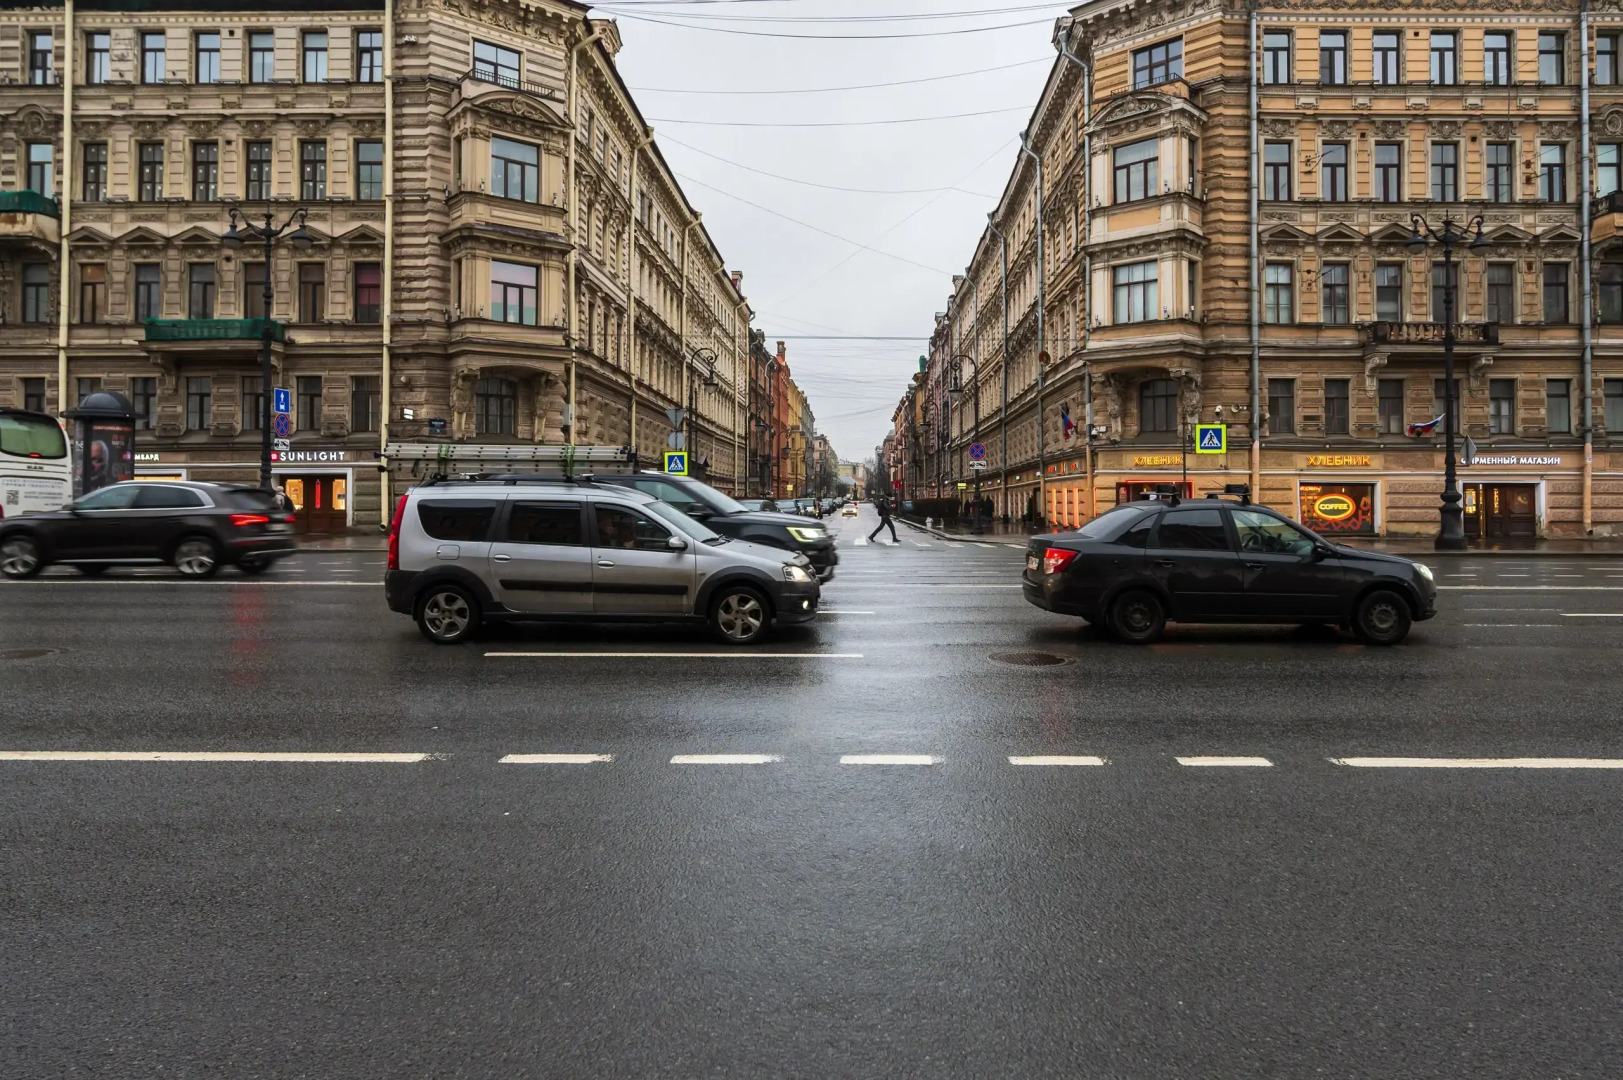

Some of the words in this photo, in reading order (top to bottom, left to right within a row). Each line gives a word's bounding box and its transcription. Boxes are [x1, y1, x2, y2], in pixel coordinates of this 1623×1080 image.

[280, 452, 345, 461] SUNLIGHT
[1133, 456, 1183, 466] ХЛЕБНИК
[1307, 456, 1370, 466] ХЛЕБНИК
[1519, 457, 1561, 465] МАГАЗИН
